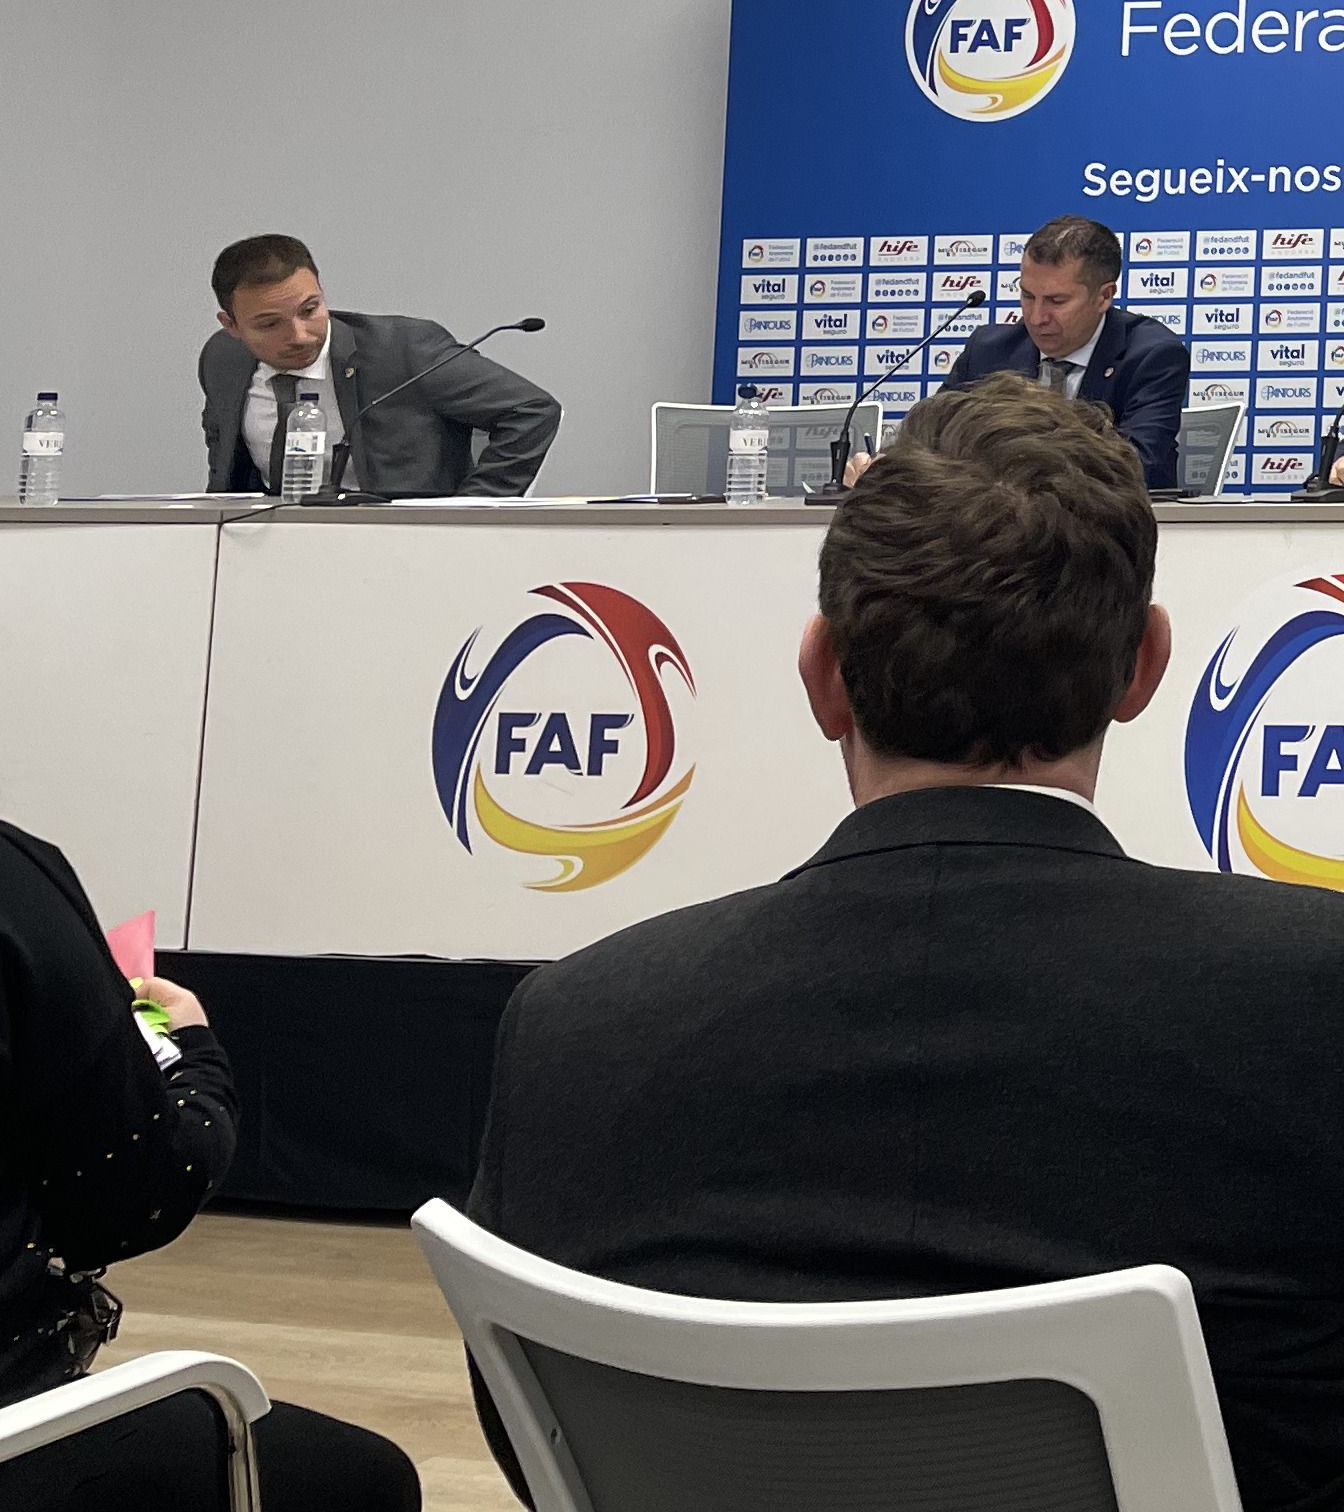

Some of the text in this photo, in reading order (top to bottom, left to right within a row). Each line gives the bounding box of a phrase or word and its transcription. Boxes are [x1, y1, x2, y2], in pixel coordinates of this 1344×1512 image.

[949, 17, 1031, 54] FAF
[753, 279, 785, 293] vital
[1141, 272, 1175, 286] vital
[814, 314, 847, 328] vital
[1205, 308, 1239, 322] vital
[1270, 344, 1305, 359] vital
[495, 711, 635, 777] FAF
